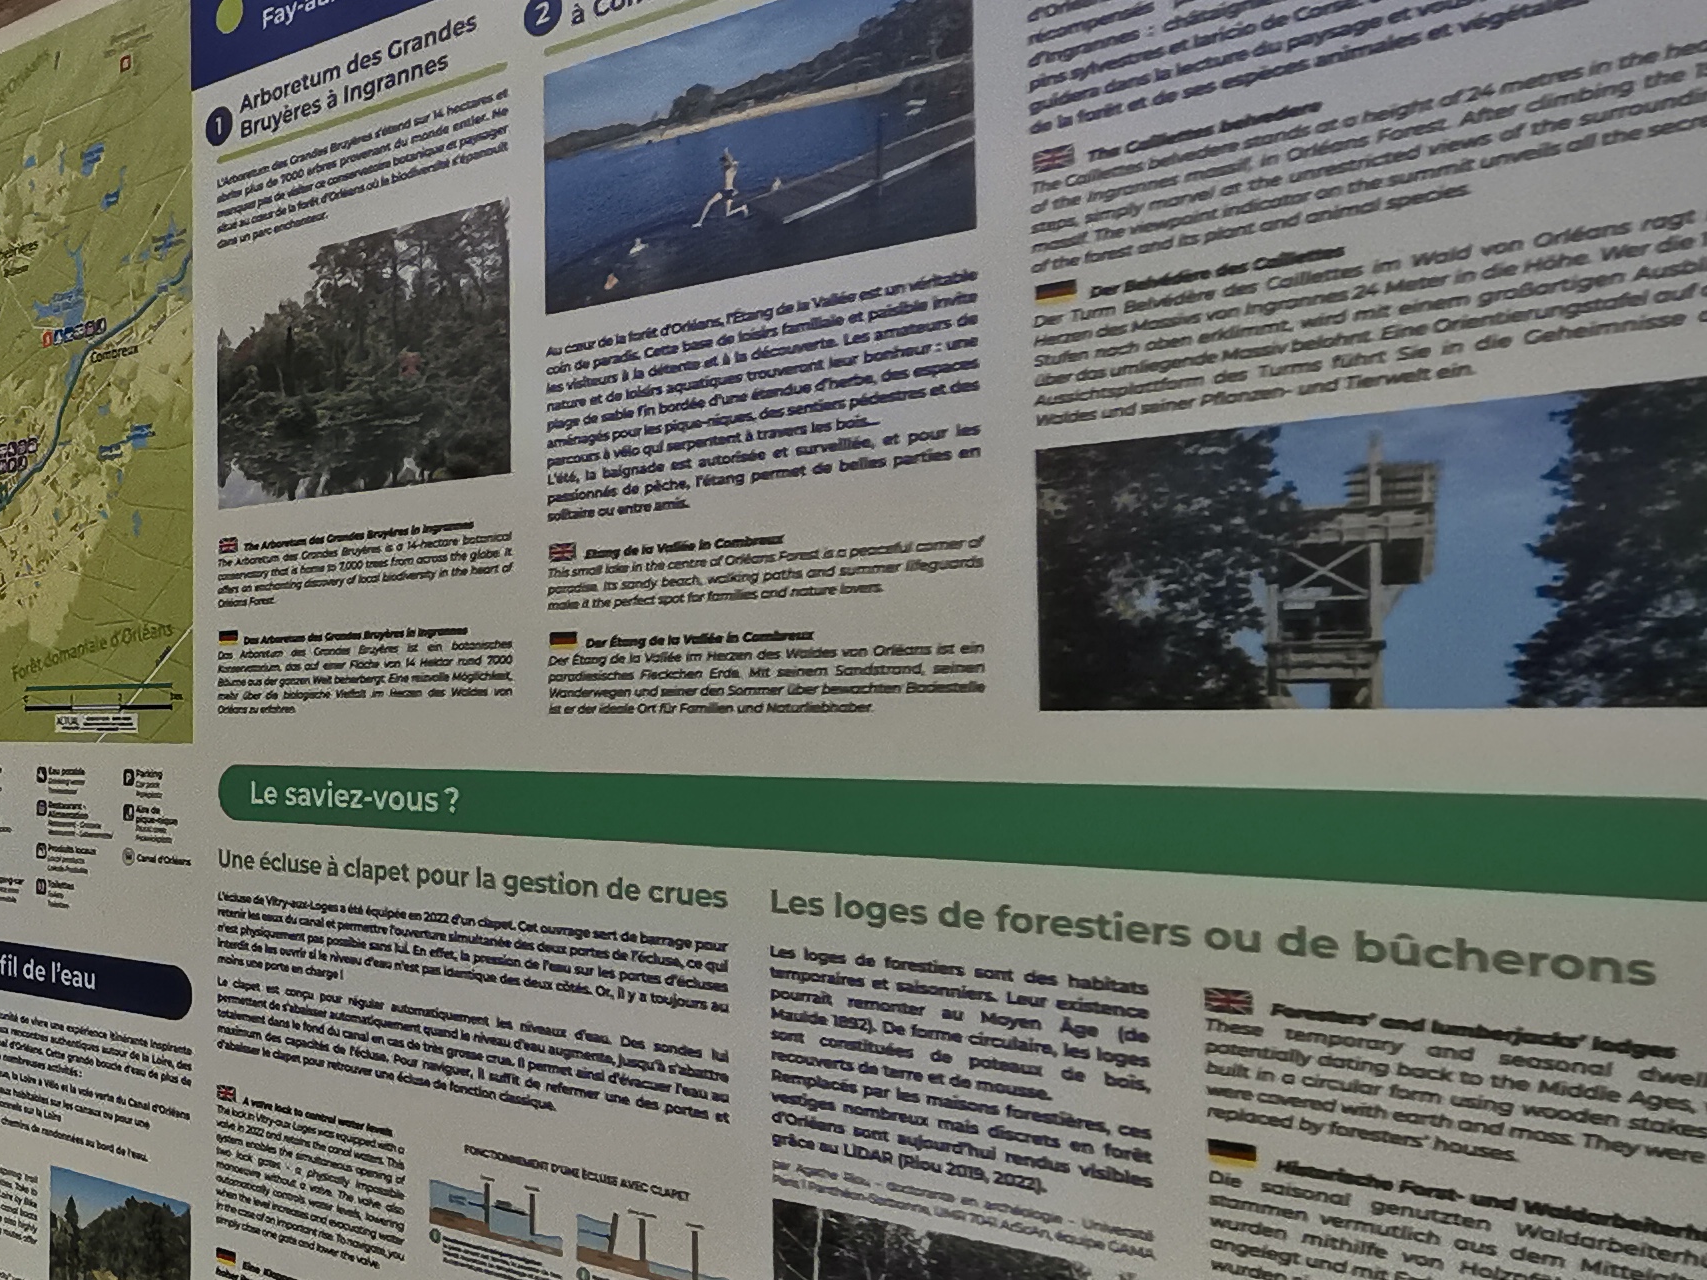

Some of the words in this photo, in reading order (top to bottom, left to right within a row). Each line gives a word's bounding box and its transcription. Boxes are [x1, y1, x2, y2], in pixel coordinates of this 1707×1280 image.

[534, 1, 551, 26] 2
[570, 2, 585, 26] à
[239, 64, 341, 114] Arboretum
[346, 49, 382, 74] des
[387, 15, 477, 59] Grandes
[1028, 119, 1052, 134] de
[1056, 114, 1073, 129] la
[1075, 102, 1124, 123] forêt
[1126, 96, 1148, 112] et
[1150, 89, 1179, 106] de
[1181, 80, 1217, 99] ses
[1219, 58, 1311, 89] espèces
[1313, 31, 1423, 67] animales
[1425, 23, 1453, 41] et
[240, 98, 322, 138] Bruyères
[326, 93, 337, 109] à
[343, 54, 448, 104] Ingrannes
[214, 117, 223, 136] 1
[1050, 255, 1081, 270] the
[1082, 244, 1134, 264] forest
[1136, 235, 1174, 254] and
[1202, 222, 1257, 245] plant
[1258, 211, 1302, 232] and
[1304, 197, 1382, 224] animal
[1383, 184, 1471, 210] species.
[545, 345, 563, 357] Au
[597, 335, 614, 348] de
[614, 333, 627, 346] la
[627, 326, 658, 342] forêt
[775, 301, 794, 316] de
[795, 300, 810, 312] la
[810, 291, 857, 308] Vallée
[858, 286, 883, 302] est
[884, 283, 907, 296] un
[907, 269, 978, 292] véritable
[90, 345, 139, 363] Combreux
[1035, 409, 1098, 426] Waldes
[1099, 401, 1137, 419] und
[1138, 397, 1197, 415] seiner
[1297, 377, 1342, 396] und
[1343, 367, 1432, 390] Tierwelt
[1435, 363, 1475, 379] ein.
[12, 656, 43, 681] Forêt
[44, 637, 106, 669] domaniale
[250, 780, 278, 805] Le
[284, 779, 439, 811] saviez-vous
[444, 786, 460, 814] ?
[217, 847, 255, 870] Une
[259, 850, 322, 875] écluse
[326, 854, 338, 877] à
[343, 856, 410, 886] clapet
[416, 866, 470, 889] pour
[475, 865, 496, 890] la
[501, 873, 598, 898] gestion
[606, 876, 640, 901] de
[648, 885, 728, 908] crues
[770, 888, 824, 917] Les
[834, 892, 928, 929] loges
[937, 900, 985, 930] de
[993, 904, 1191, 947] forestiers
[1204, 927, 1261, 953] ou
[1276, 925, 1339, 959] de
[1354, 929, 1656, 986] bûcherons
[0, 953, 17, 977] fil
[22, 958, 45, 981] de
[51, 961, 95, 989] l'eau
[769, 944, 796, 959] Les
[803, 947, 847, 966] loges
[854, 952, 876, 967] de
[883, 955, 966, 977] forestiers
[973, 967, 1014, 982] sont
[1023, 969, 1058, 986] des
[1067, 973, 1149, 995] habitats
[771, 1133, 815, 1150] grâce
[817, 1141, 839, 1155] au
[1206, 1106, 1294, 1129] replaced
[1297, 1116, 1326, 1135] by
[1431, 1135, 1519, 1162] houses.
